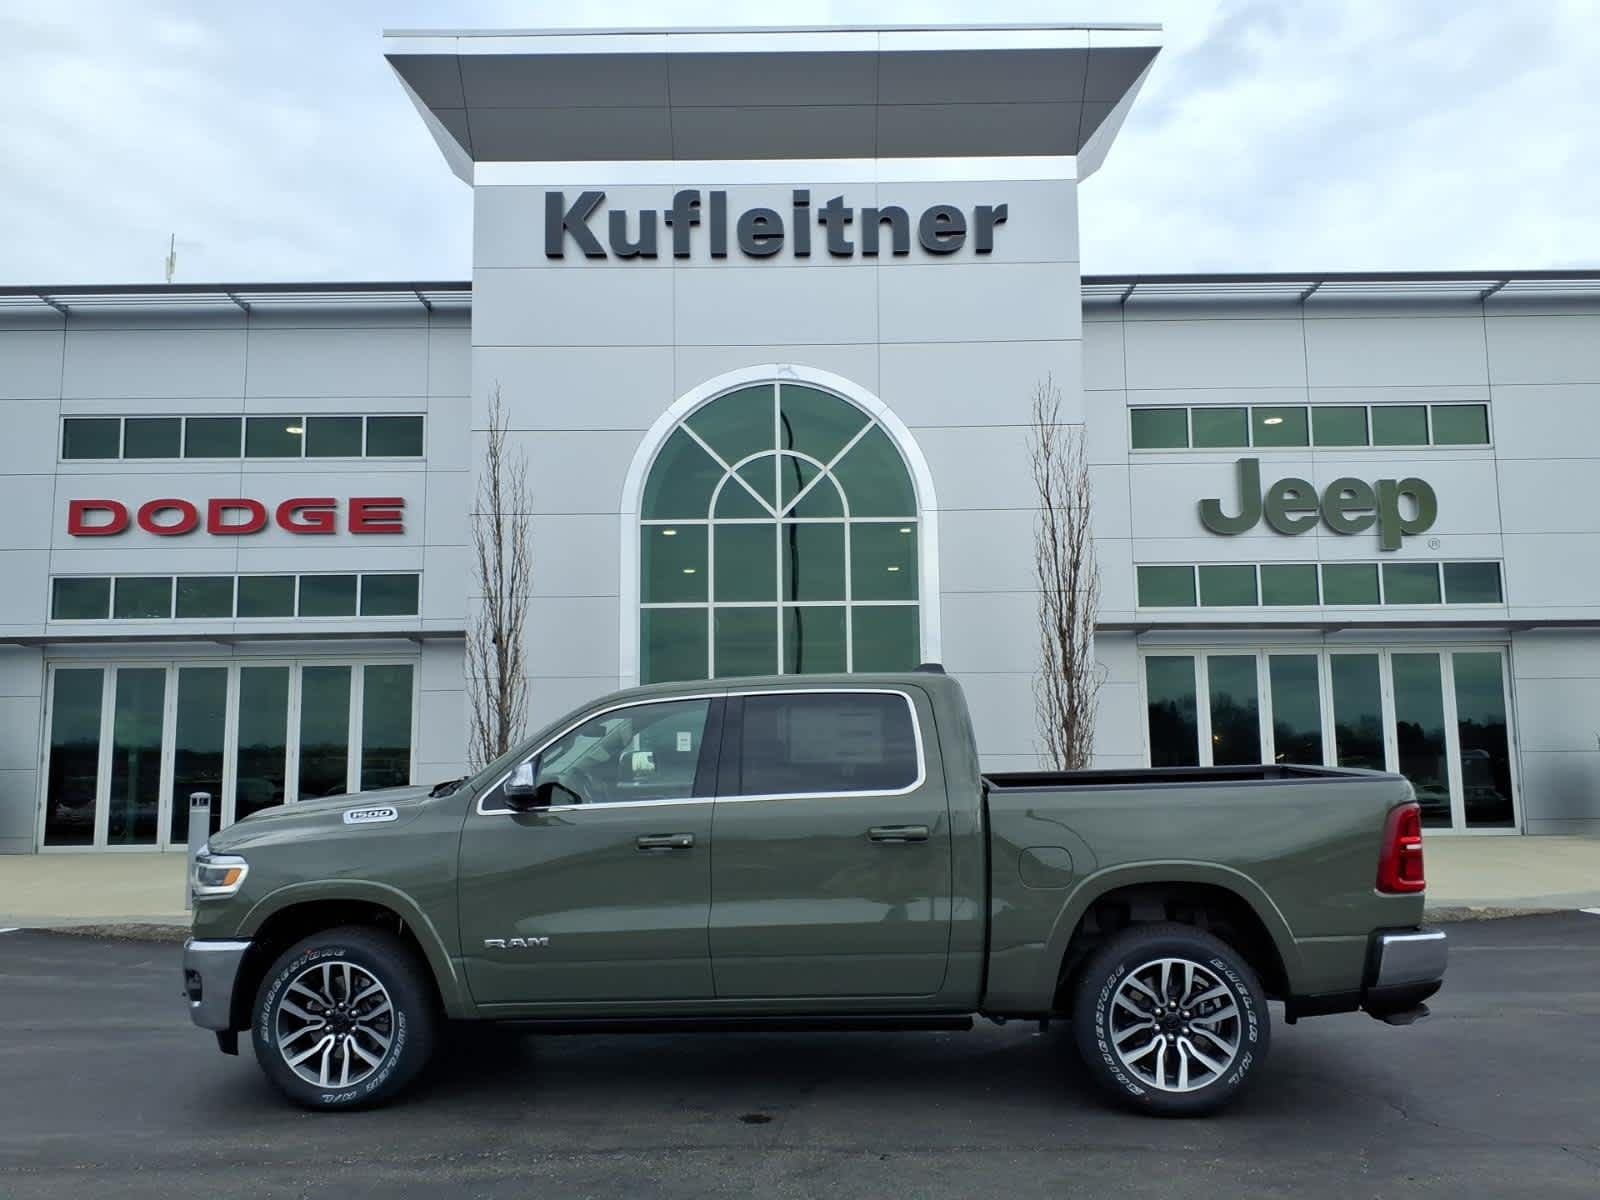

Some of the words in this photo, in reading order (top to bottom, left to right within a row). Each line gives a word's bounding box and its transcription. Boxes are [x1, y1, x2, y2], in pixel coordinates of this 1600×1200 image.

[545, 189, 1008, 259] Kufleitner
[68, 497, 406, 535] DODGE
[1199, 458, 1437, 551] Jeep
[350, 808, 393, 820] 1500
[484, 937, 549, 949] RAM
